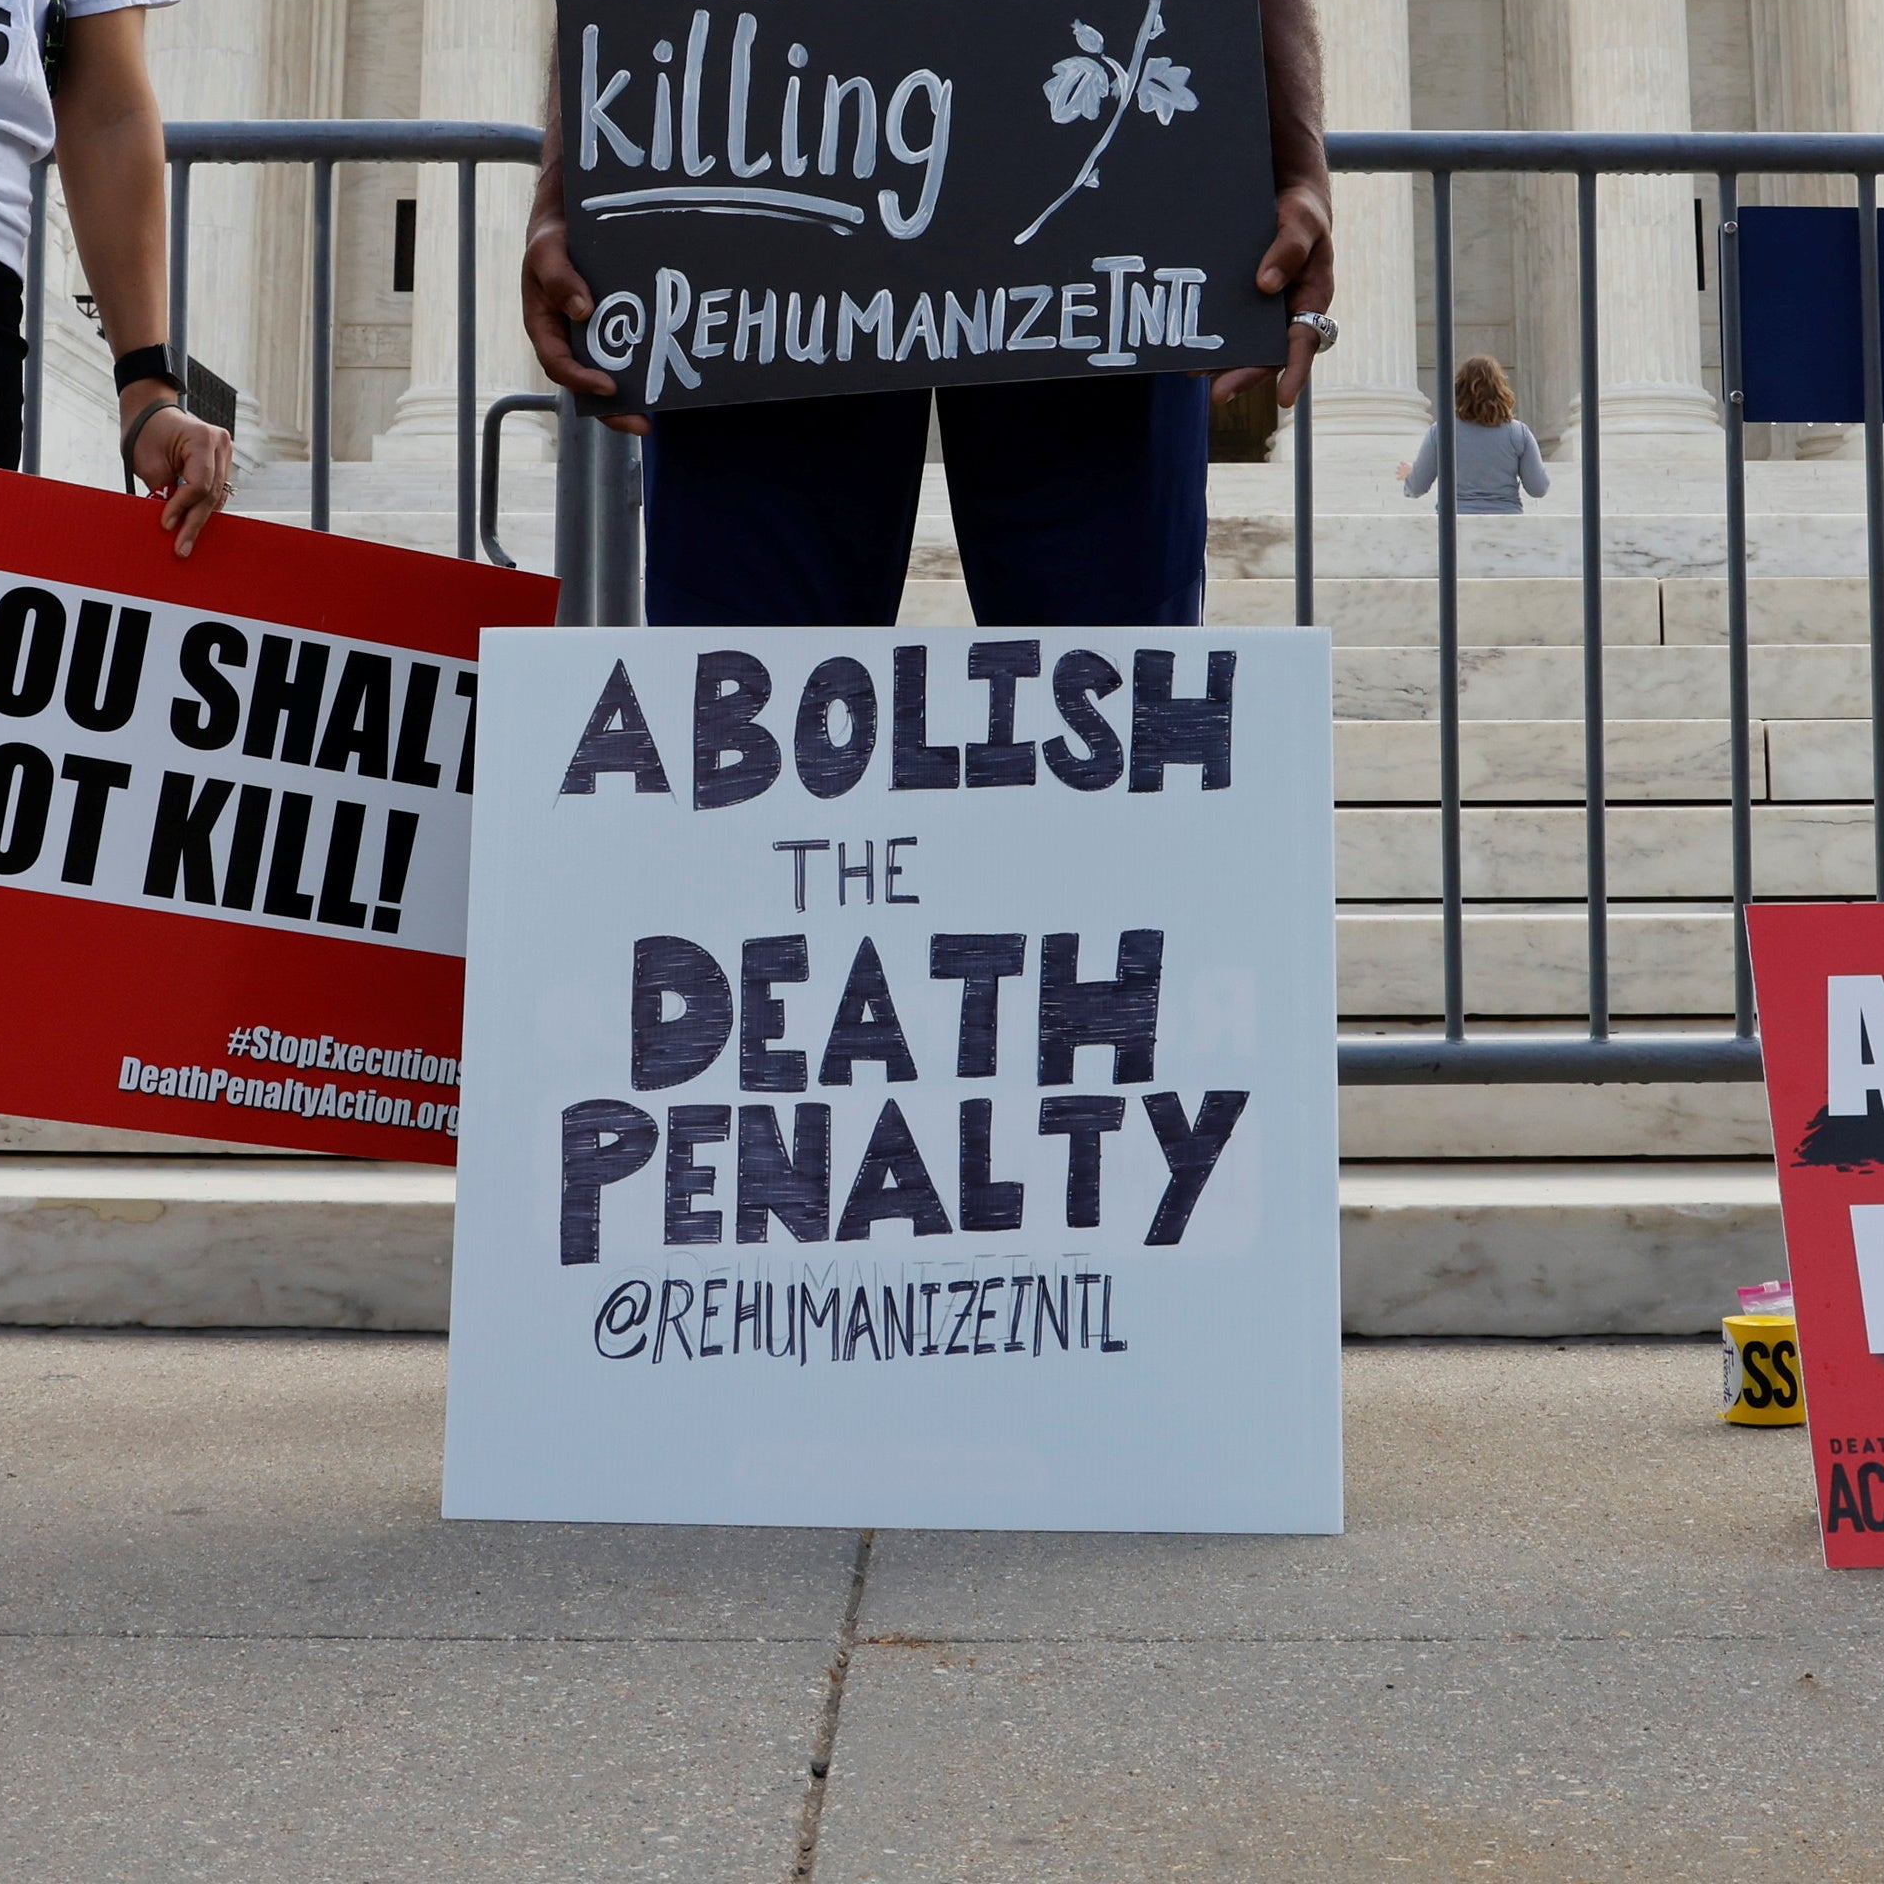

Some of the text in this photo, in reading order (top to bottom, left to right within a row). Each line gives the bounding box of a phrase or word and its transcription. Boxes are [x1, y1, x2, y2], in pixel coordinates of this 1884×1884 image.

[579, 10, 952, 239] killing
[557, 639, 1237, 811] ABOLISH
[142, 769, 420, 935] KILL!
[772, 837, 921, 913] THE
[630, 928, 1165, 1093] DEATH
[560, 1089, 1251, 1266] PENALTY
[594, 1273, 1128, 1366] @REHUMANIZEINTL
[1735, 1340, 1798, 1409] SS
